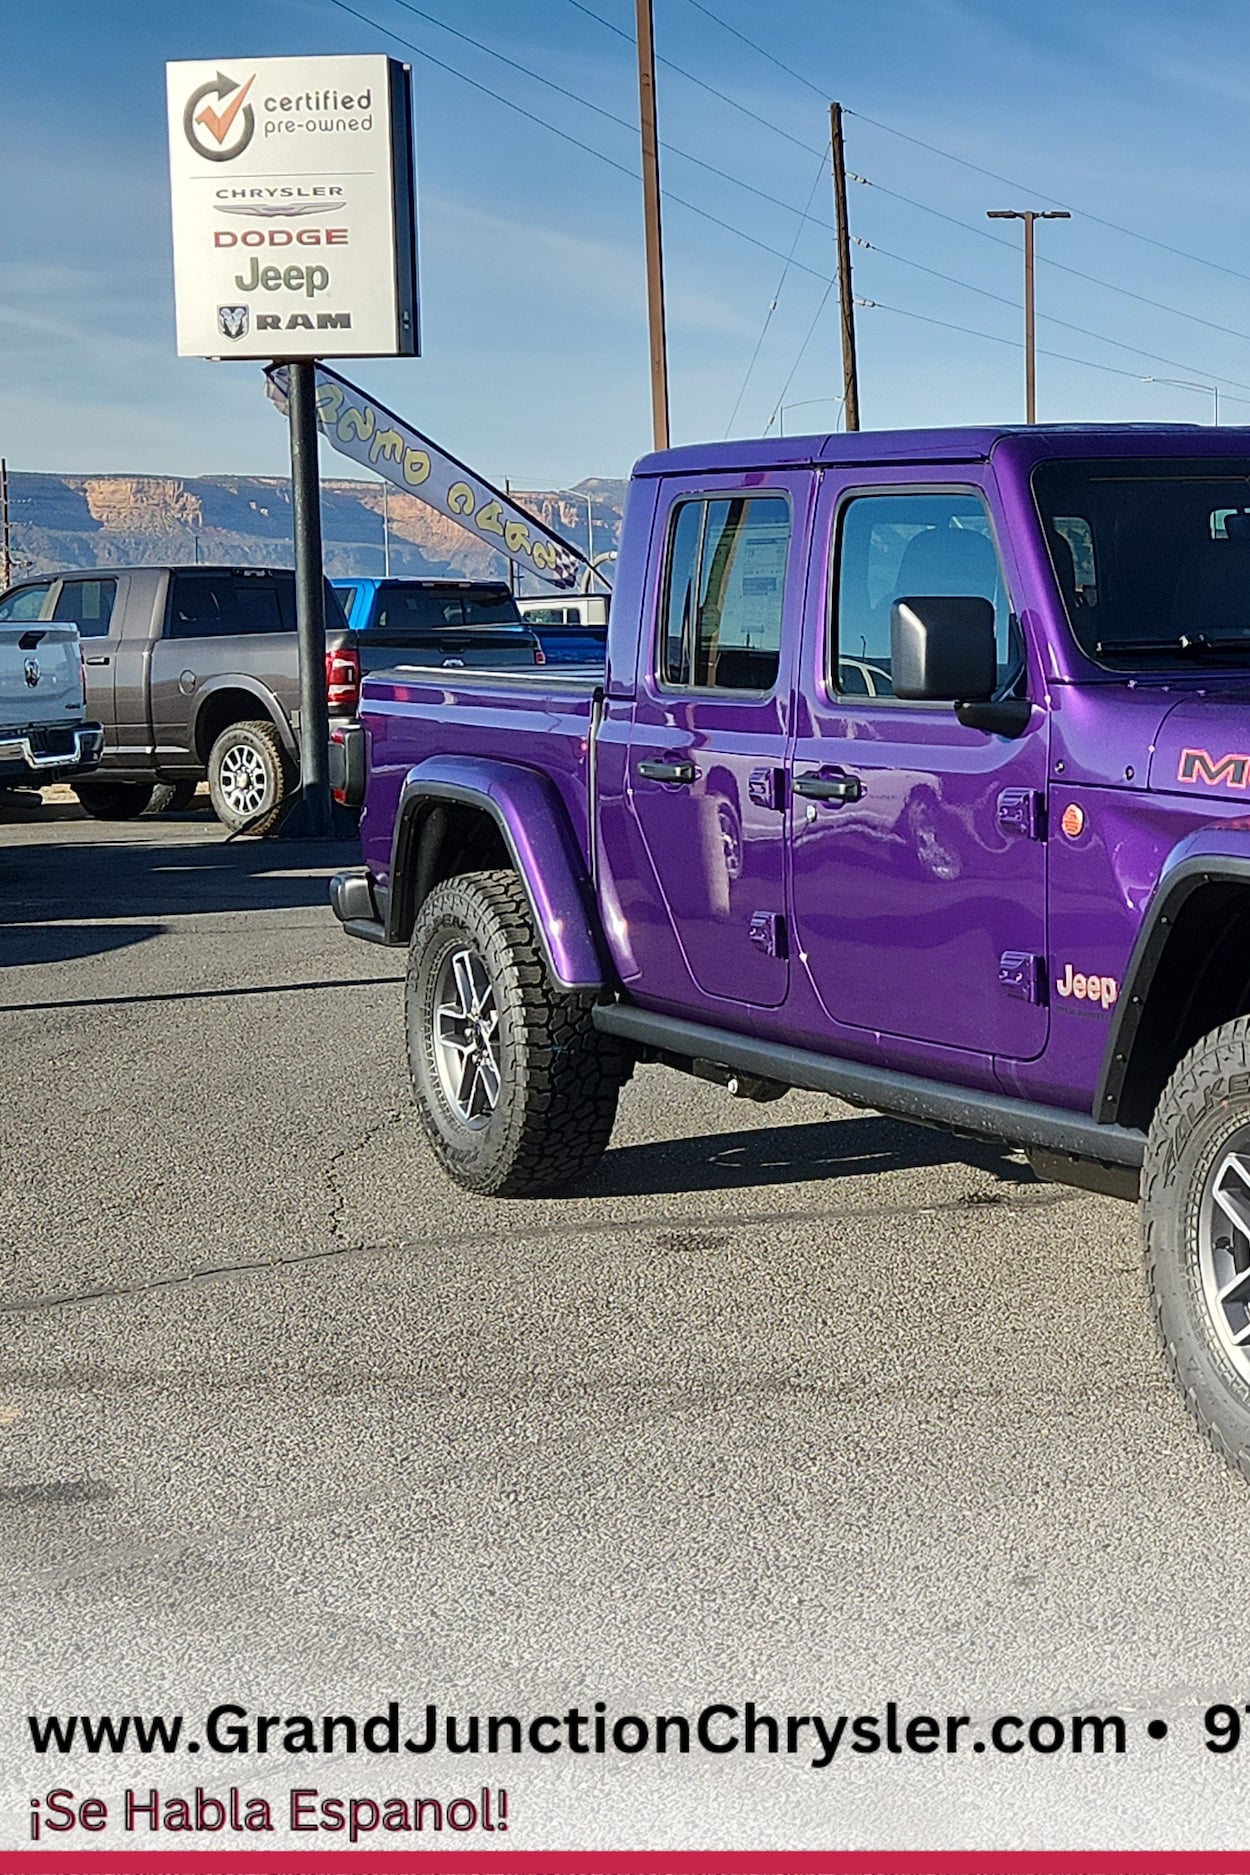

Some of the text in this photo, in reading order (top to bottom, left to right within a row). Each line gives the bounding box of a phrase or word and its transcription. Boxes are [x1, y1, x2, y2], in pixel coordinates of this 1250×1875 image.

[263, 88, 371, 112] certified
[264, 115, 373, 138] pre-owned
[215, 187, 343, 199] CHRYSLER
[214, 228, 349, 248] DODGE
[234, 256, 330, 298] Jeep
[256, 313, 352, 330] RAM
[1056, 964, 1118, 1010] Jeep
